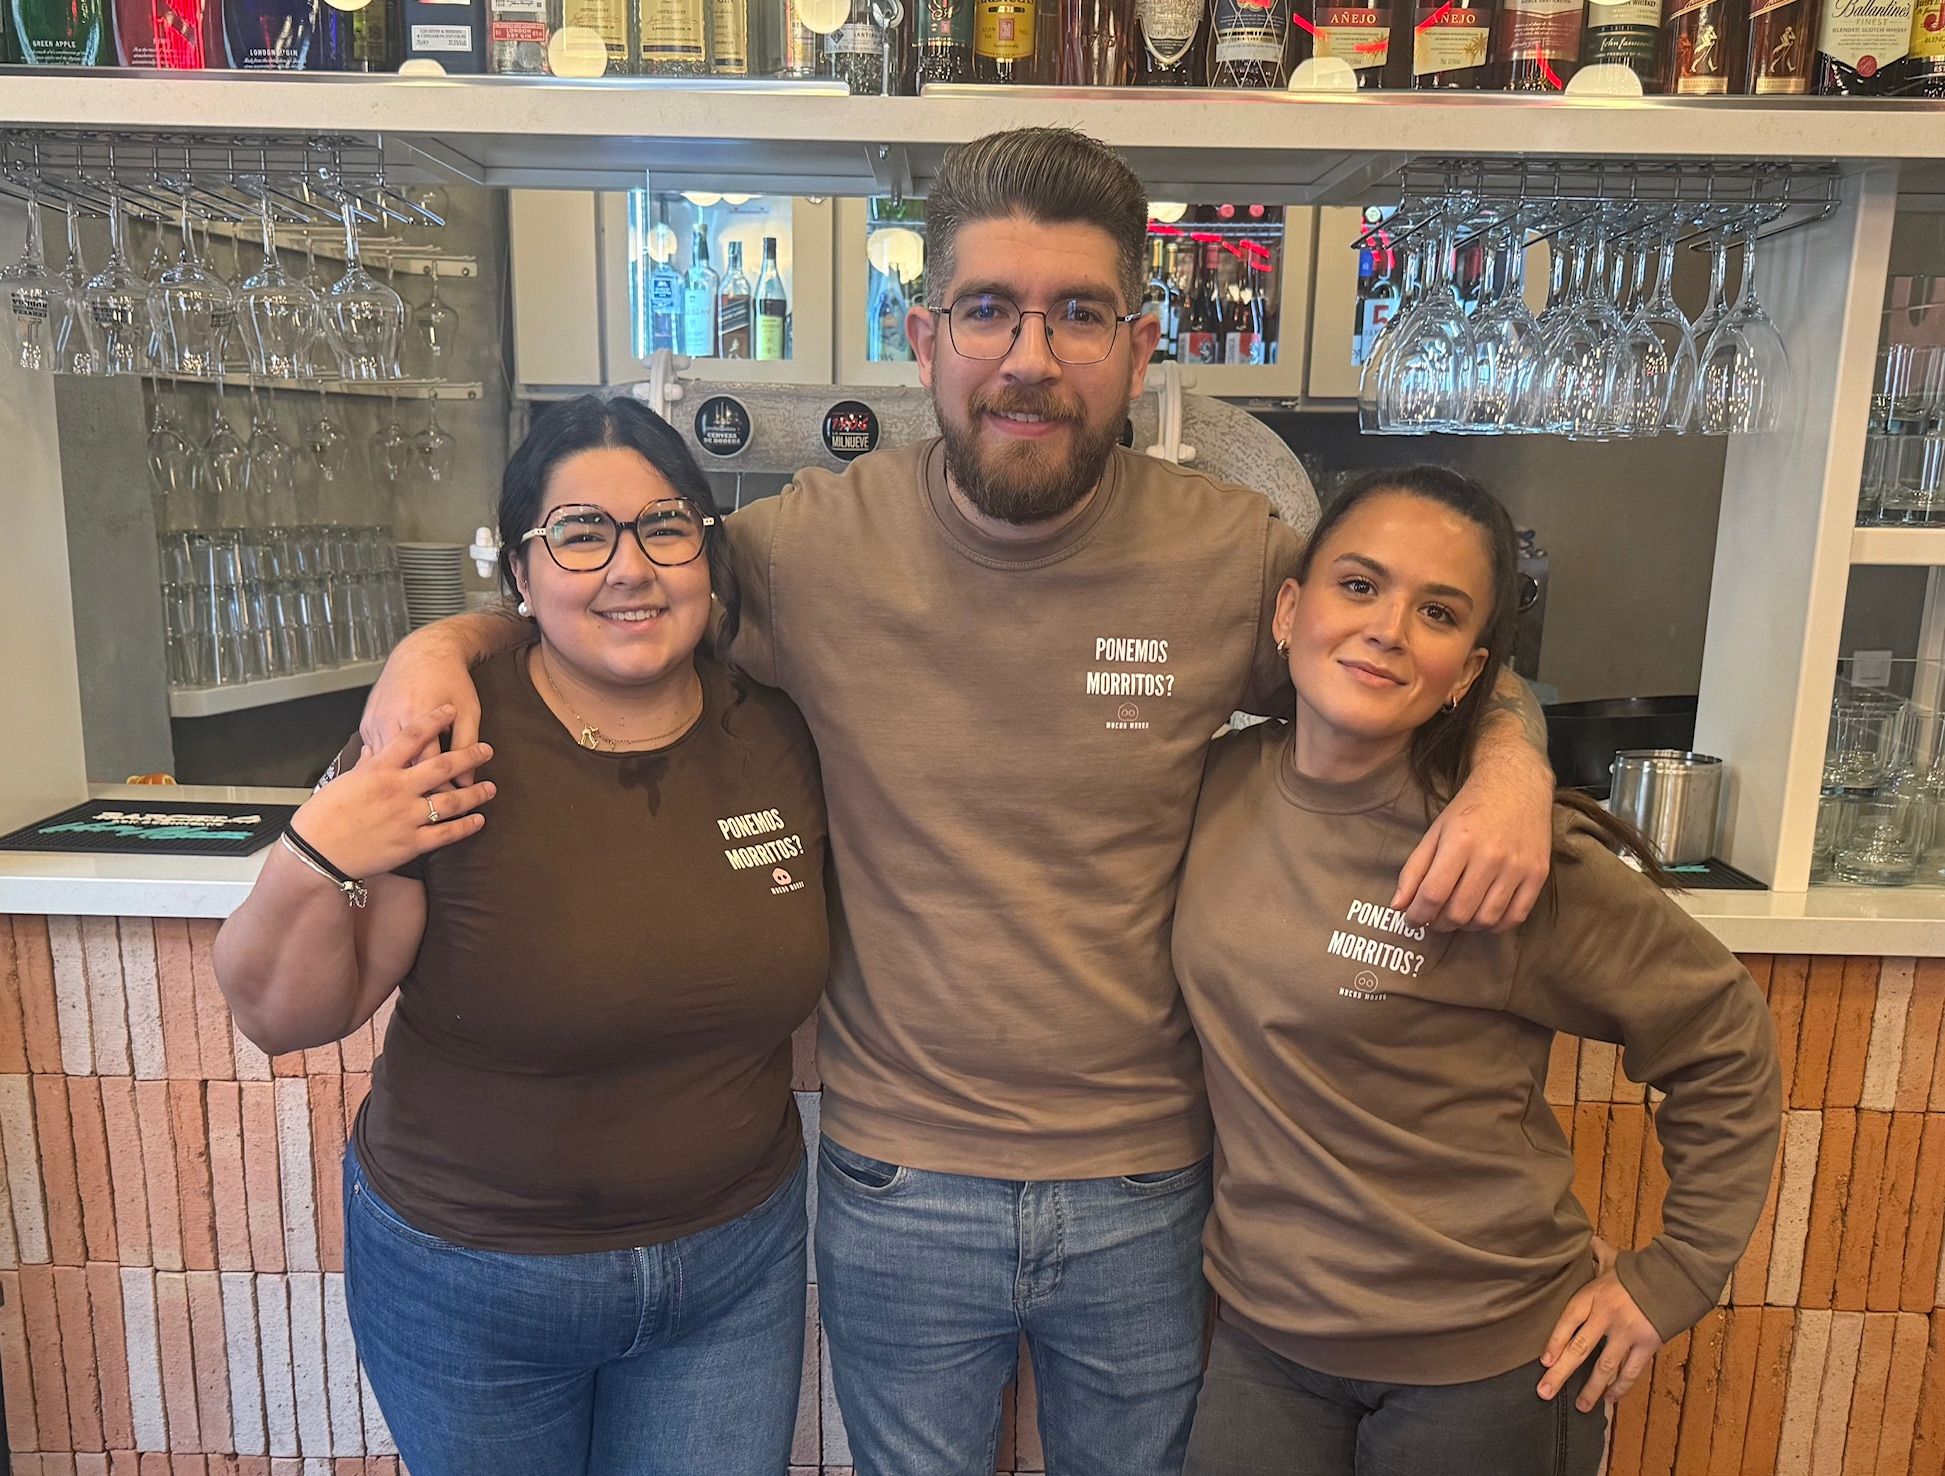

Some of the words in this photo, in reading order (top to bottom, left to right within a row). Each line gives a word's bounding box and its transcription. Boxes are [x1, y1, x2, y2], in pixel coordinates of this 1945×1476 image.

[1331, 11, 1377, 24] AÑEJO
[32, 40, 54, 48] GREEN
[832, 435, 870, 448] MILNUEVE
[1095, 637, 1169, 664] PONEMOS
[1086, 671, 1175, 697] MORRITOS?
[717, 808, 785, 840] PONEMOS
[724, 834, 804, 870] MORRITOS?
[1327, 929, 1425, 978] MORRITOS?
